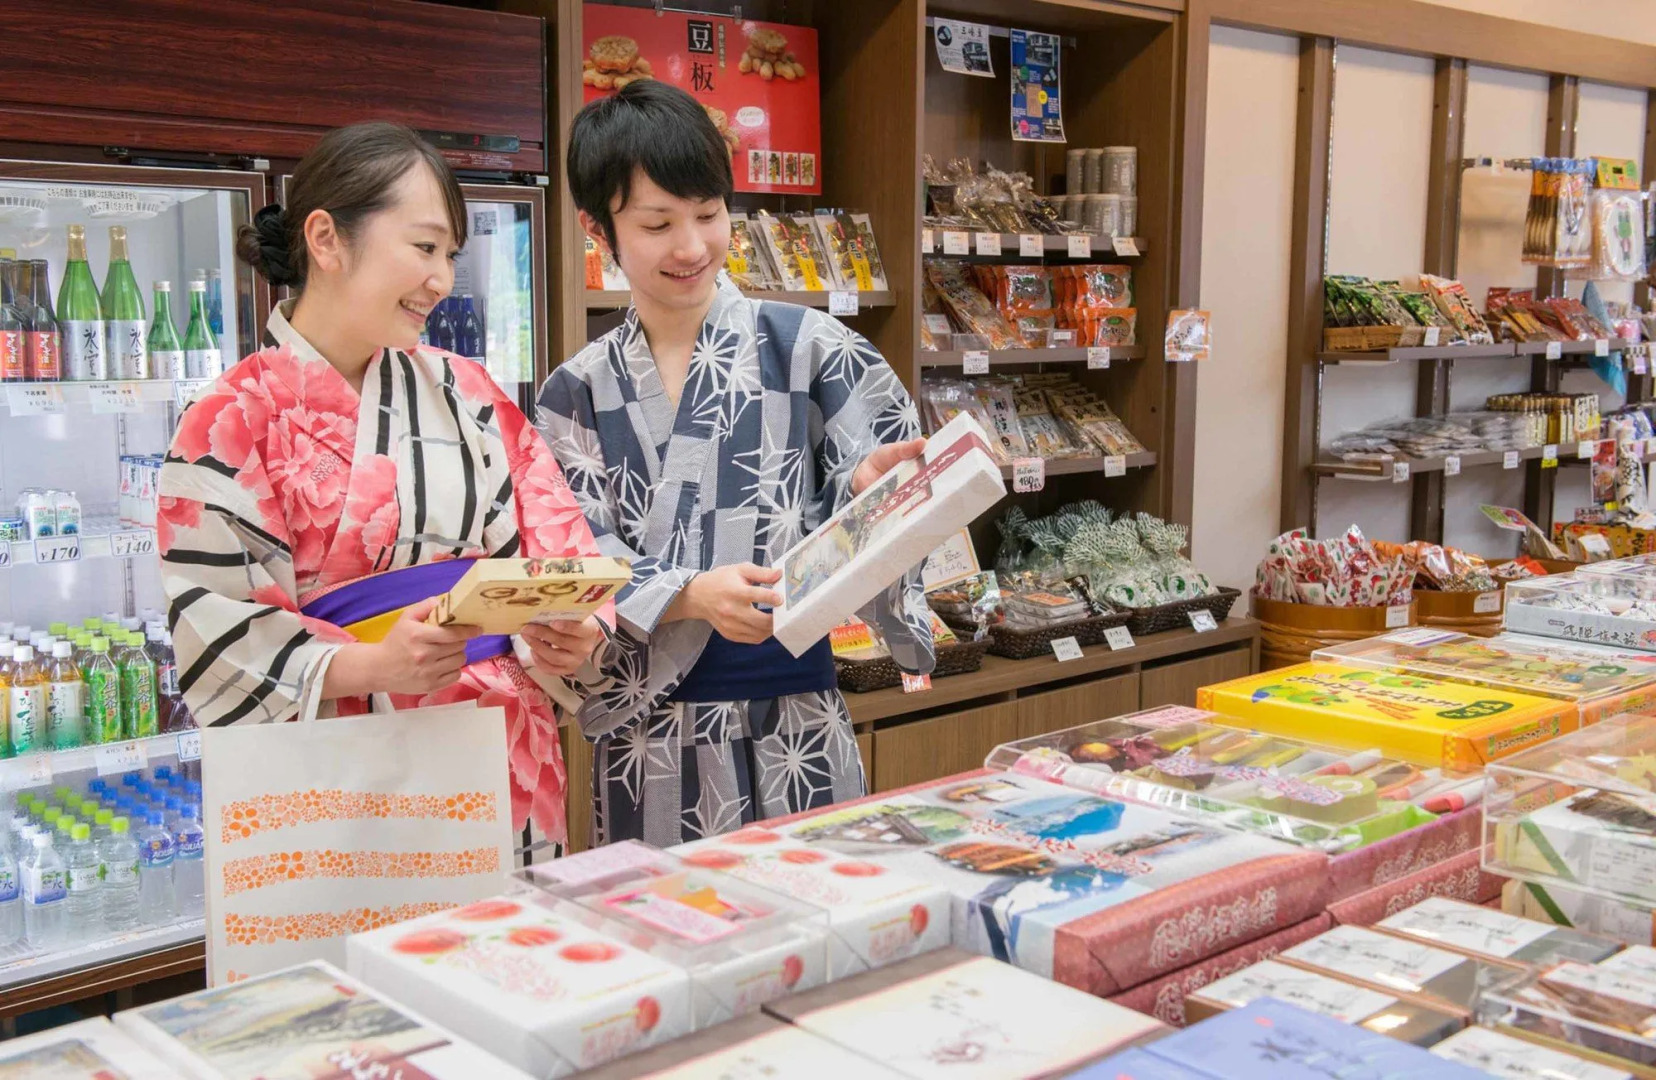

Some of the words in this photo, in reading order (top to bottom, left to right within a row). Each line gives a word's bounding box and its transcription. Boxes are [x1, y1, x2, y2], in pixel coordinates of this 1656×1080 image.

[116, 533, 147, 541] コーヒー
[41, 546, 79, 561] ¥170
[116, 540, 152, 555] ¥140
[104, 677, 117, 709] 生茶
[137, 672, 151, 704] 生茶
